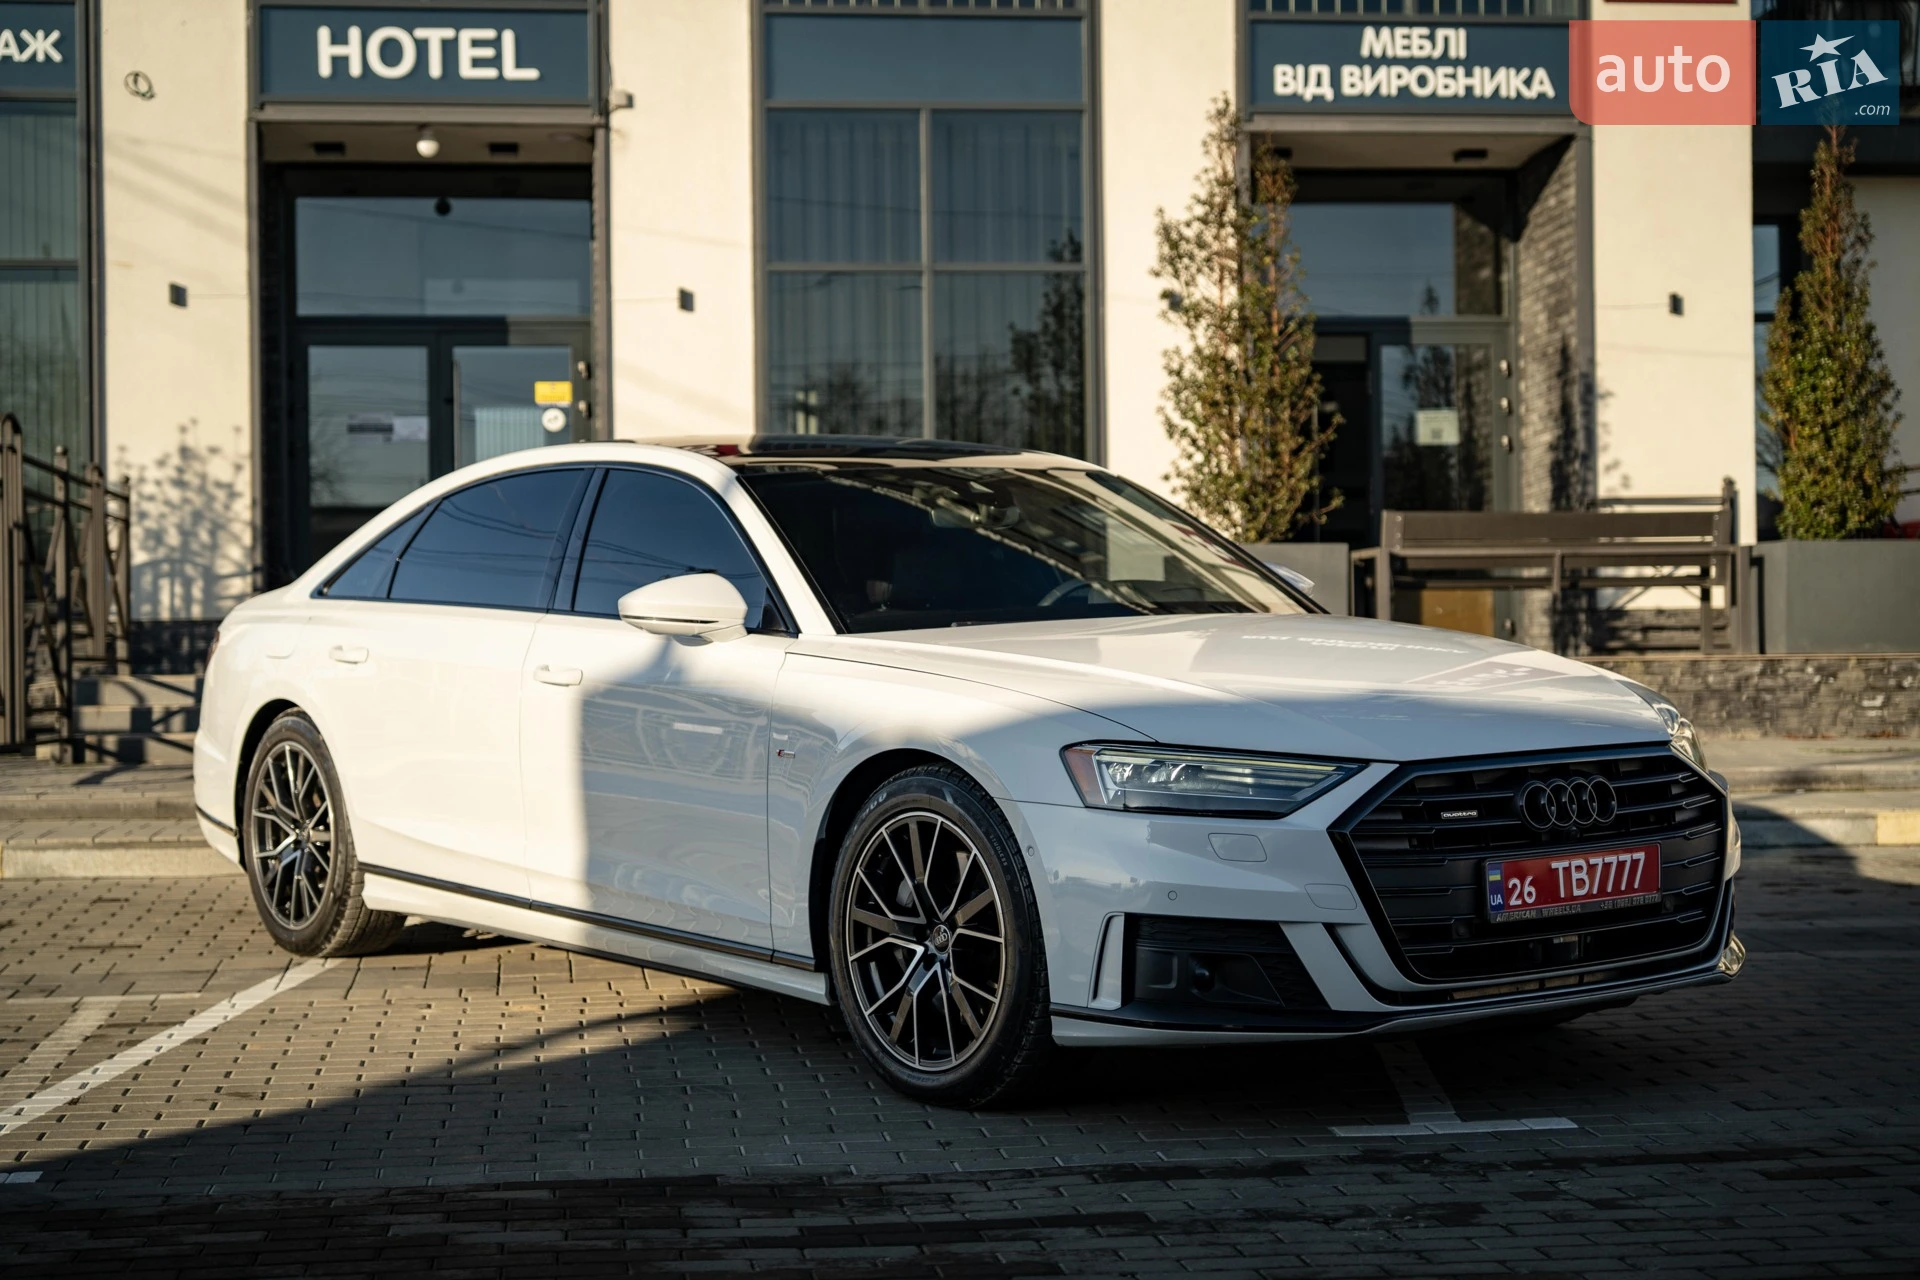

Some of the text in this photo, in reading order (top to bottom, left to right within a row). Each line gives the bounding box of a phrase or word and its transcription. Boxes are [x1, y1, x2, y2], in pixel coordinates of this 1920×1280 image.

[317, 25, 541, 81] HOTEL
[1360, 26, 1467, 60] МЕБЛІ
[1273, 64, 1556, 102] ВІД ВИРОБНИКА
[1508, 852, 1645, 906] 26 TB7777
[1490, 894, 1503, 906] UA
